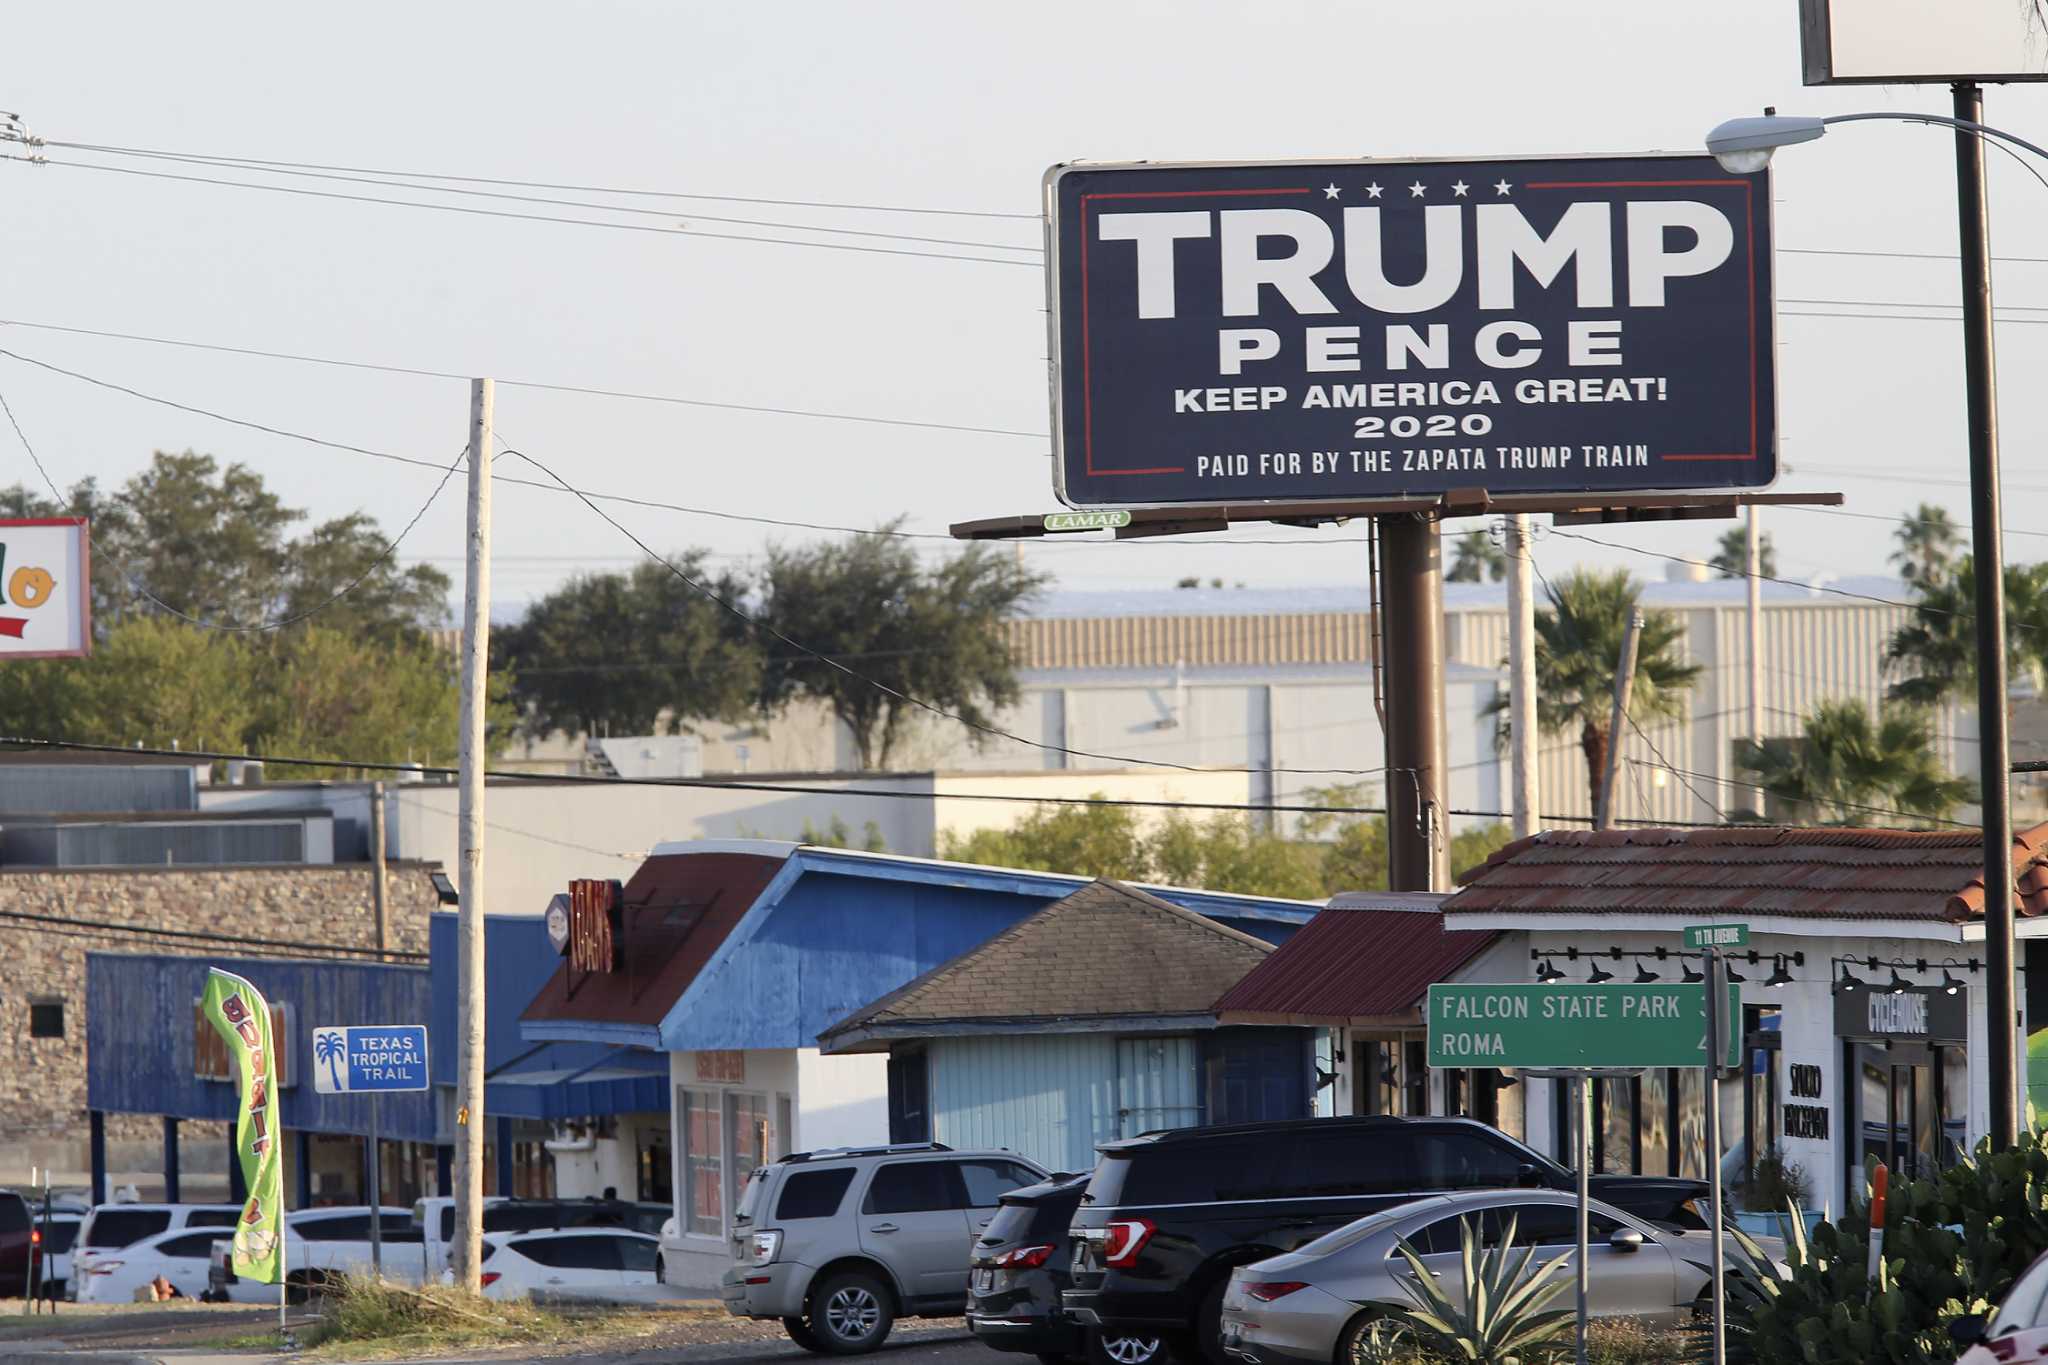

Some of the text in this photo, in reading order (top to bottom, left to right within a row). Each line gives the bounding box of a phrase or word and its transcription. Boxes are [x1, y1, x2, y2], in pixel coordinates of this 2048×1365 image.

[1098, 200, 1734, 320] TRUMP
[1218, 320, 1624, 375] PENCE
[1174, 377, 1667, 413] KEEP AMERICA GREAT!
[1353, 413, 1493, 439] 2020
[1197, 444, 1648, 477] PAID FOR BY THE ZAPATA TRUMP TRAIN
[1051, 513, 1121, 528] LAMAR
[1694, 930, 1702, 945] 11
[1714, 928, 1740, 944] AVENUE
[1442, 995, 1528, 1019] FALCON
[1542, 995, 1607, 1019] STATE
[1622, 995, 1681, 1018] PARK
[359, 1036, 414, 1050] TEXAS
[1442, 1032, 1506, 1056] ROMA
[351, 1051, 422, 1066] TROPICAL
[362, 1067, 413, 1081] TRAIL
